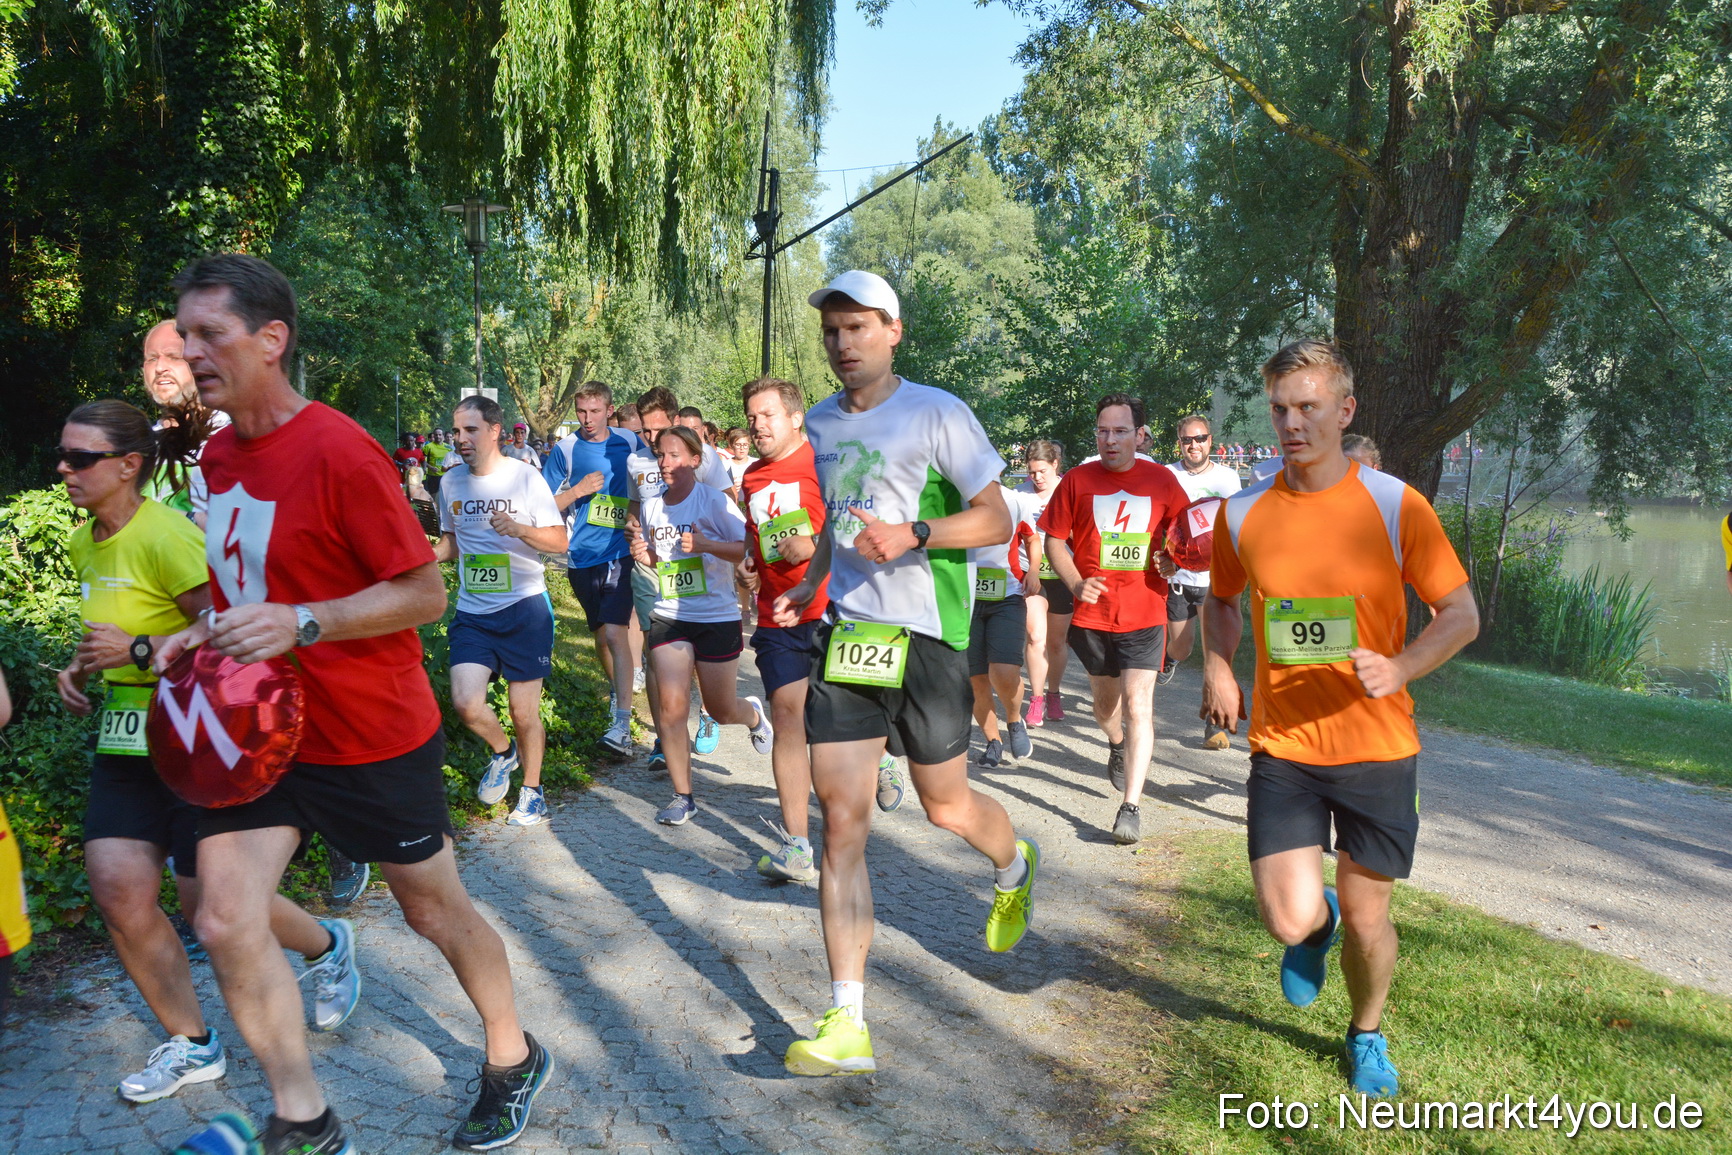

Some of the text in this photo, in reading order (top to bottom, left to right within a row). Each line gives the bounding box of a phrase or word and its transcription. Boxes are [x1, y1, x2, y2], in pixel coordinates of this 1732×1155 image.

[463, 499, 518, 514] GRADL
[595, 505, 625, 520] 1168
[655, 524, 696, 541] GRAD
[1111, 546, 1141, 560] 406
[471, 568, 498, 582] 729
[667, 572, 693, 588] 730
[975, 579, 996, 592] 251
[1291, 621, 1326, 645] 99
[837, 642, 894, 669] 1024
[1324, 644, 1352, 652] Parzival
[843, 665, 882, 675] Kraus Martin
[105, 710, 140, 736] 970
